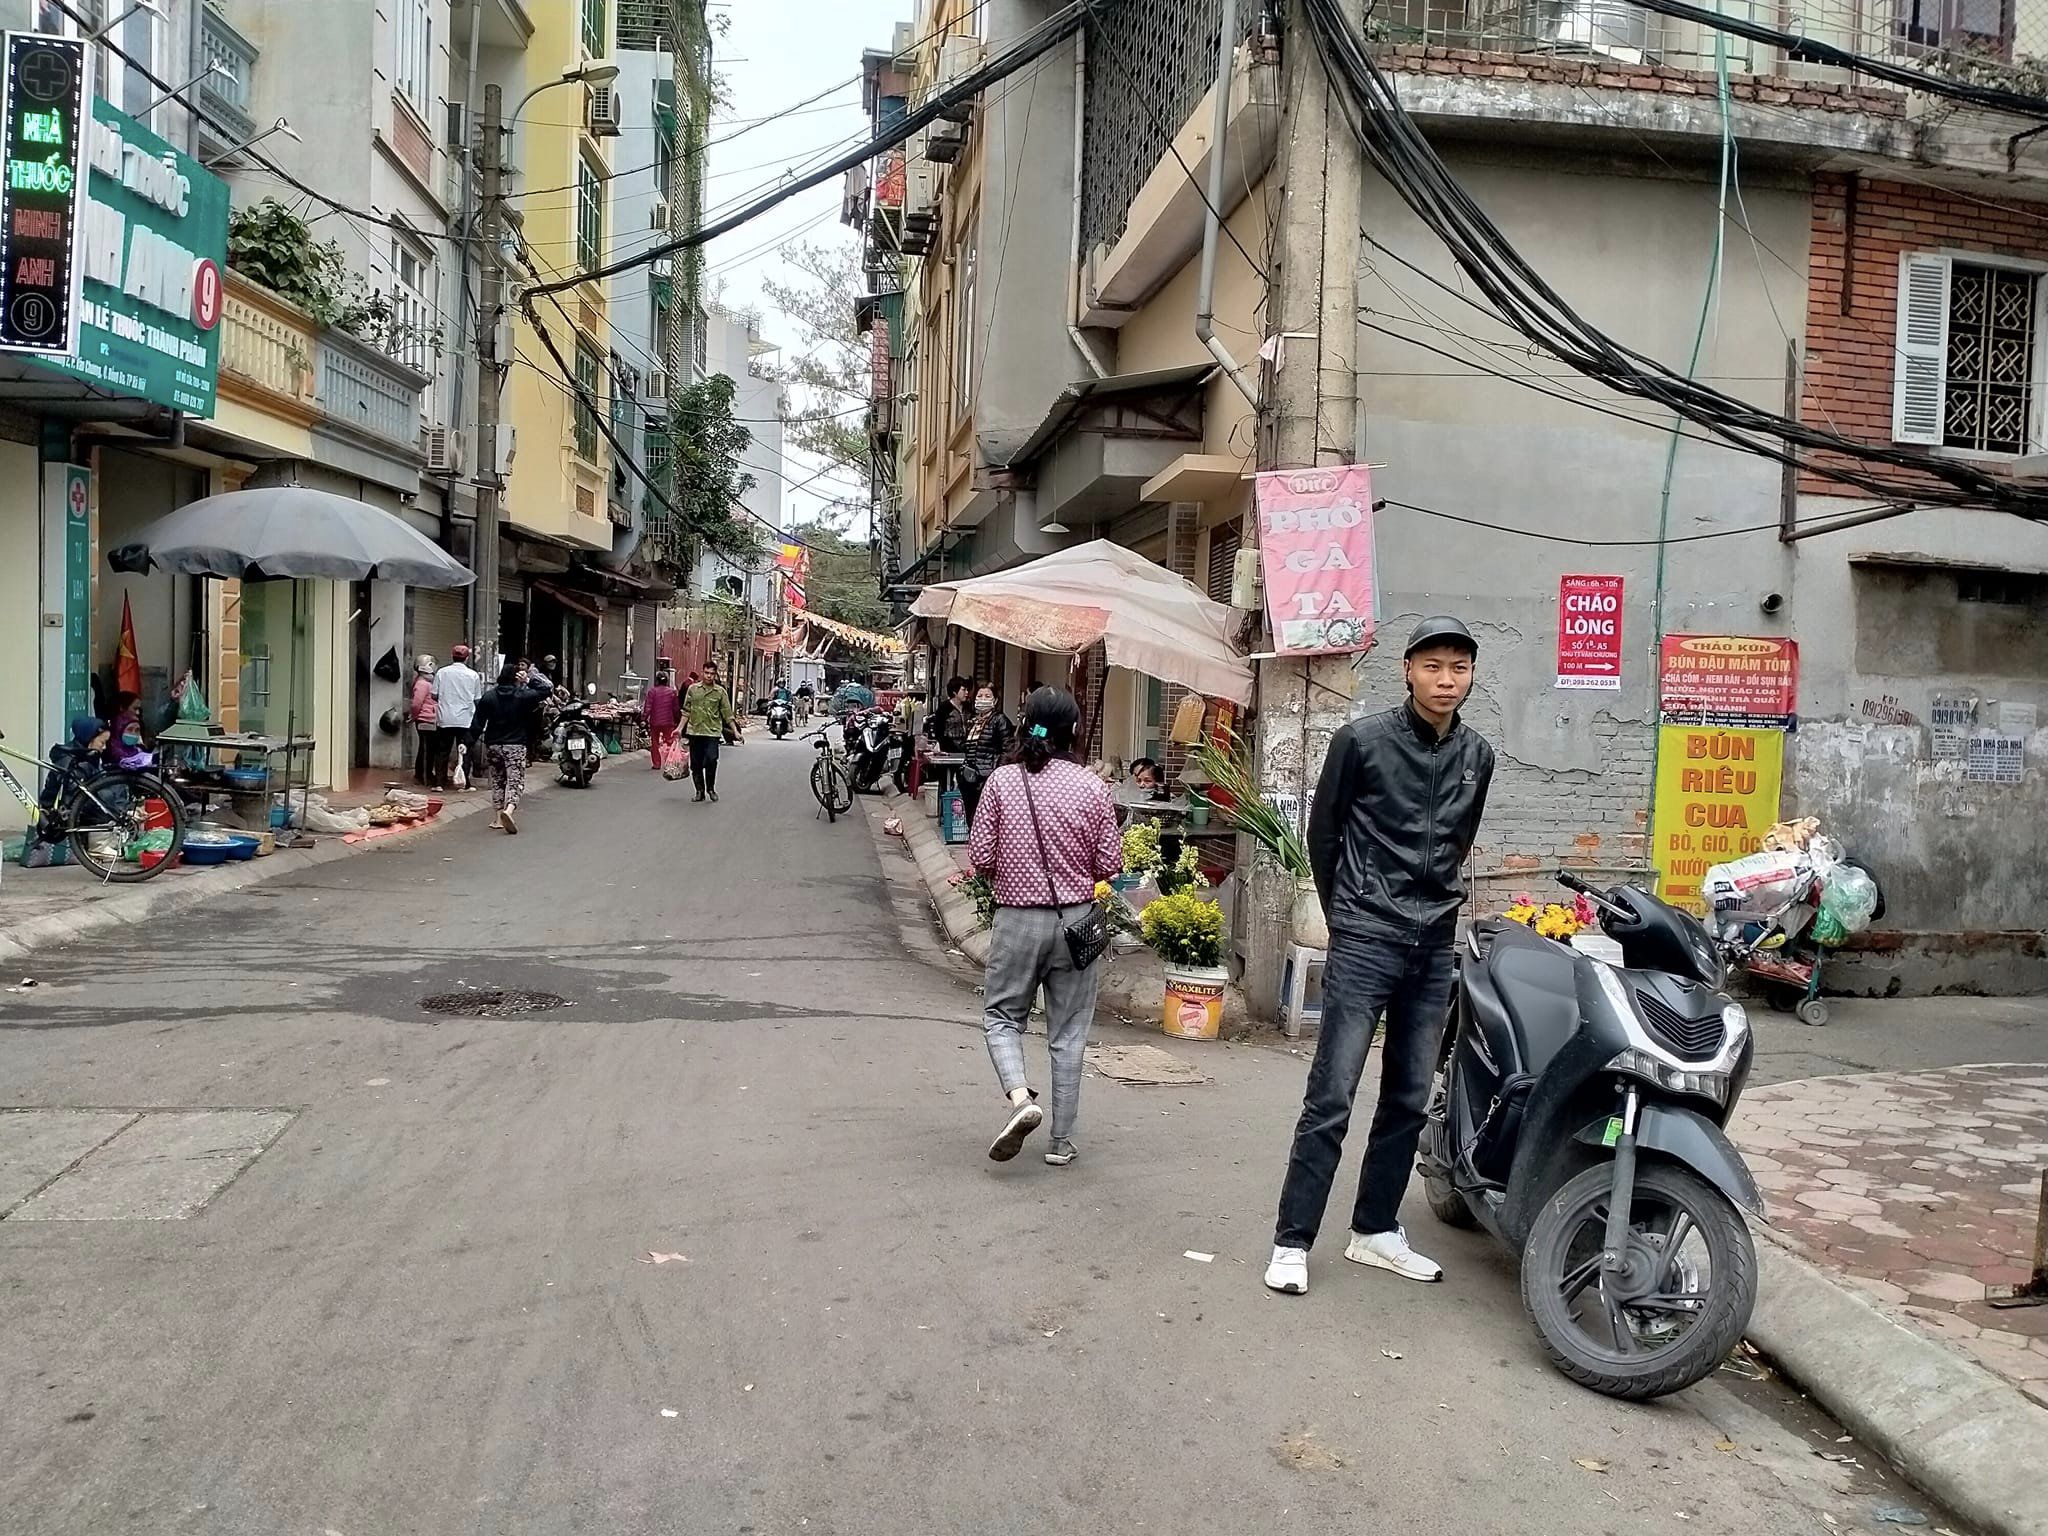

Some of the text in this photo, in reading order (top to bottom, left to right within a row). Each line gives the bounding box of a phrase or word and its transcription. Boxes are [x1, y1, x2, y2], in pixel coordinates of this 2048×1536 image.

[24, 107, 62, 144] NHÀ
[10, 152, 71, 193] THUỐC
[122, 142, 190, 217] THUỐC
[14, 208, 60, 240] MINH
[16, 257, 54, 287] ANH
[124, 223, 194, 320] ANH
[201, 267, 215, 321] 9
[23, 299, 43, 331] 9
[112, 311, 146, 345] THUỐC
[146, 325, 179, 358] THÀNH
[1267, 497, 1363, 535] PHỞ
[1285, 541, 1353, 574] GÀ
[1291, 590, 1355, 616] TA
[1566, 592, 1617, 612] CHÁO
[1565, 615, 1615, 635] LÒNG
[1692, 641, 1733, 653] THẢO
[1669, 655, 1791, 673] BÚN ĐẬU MẮM TÔM
[1686, 731, 1755, 762] BÚN
[1681, 765, 1757, 795] RIÊU
[1684, 803, 1748, 829] CUA
[1669, 830, 1696, 854] BÒ,
[1701, 830, 1733, 855] GIÒ,
[1174, 982, 1217, 995] MAXILITE
